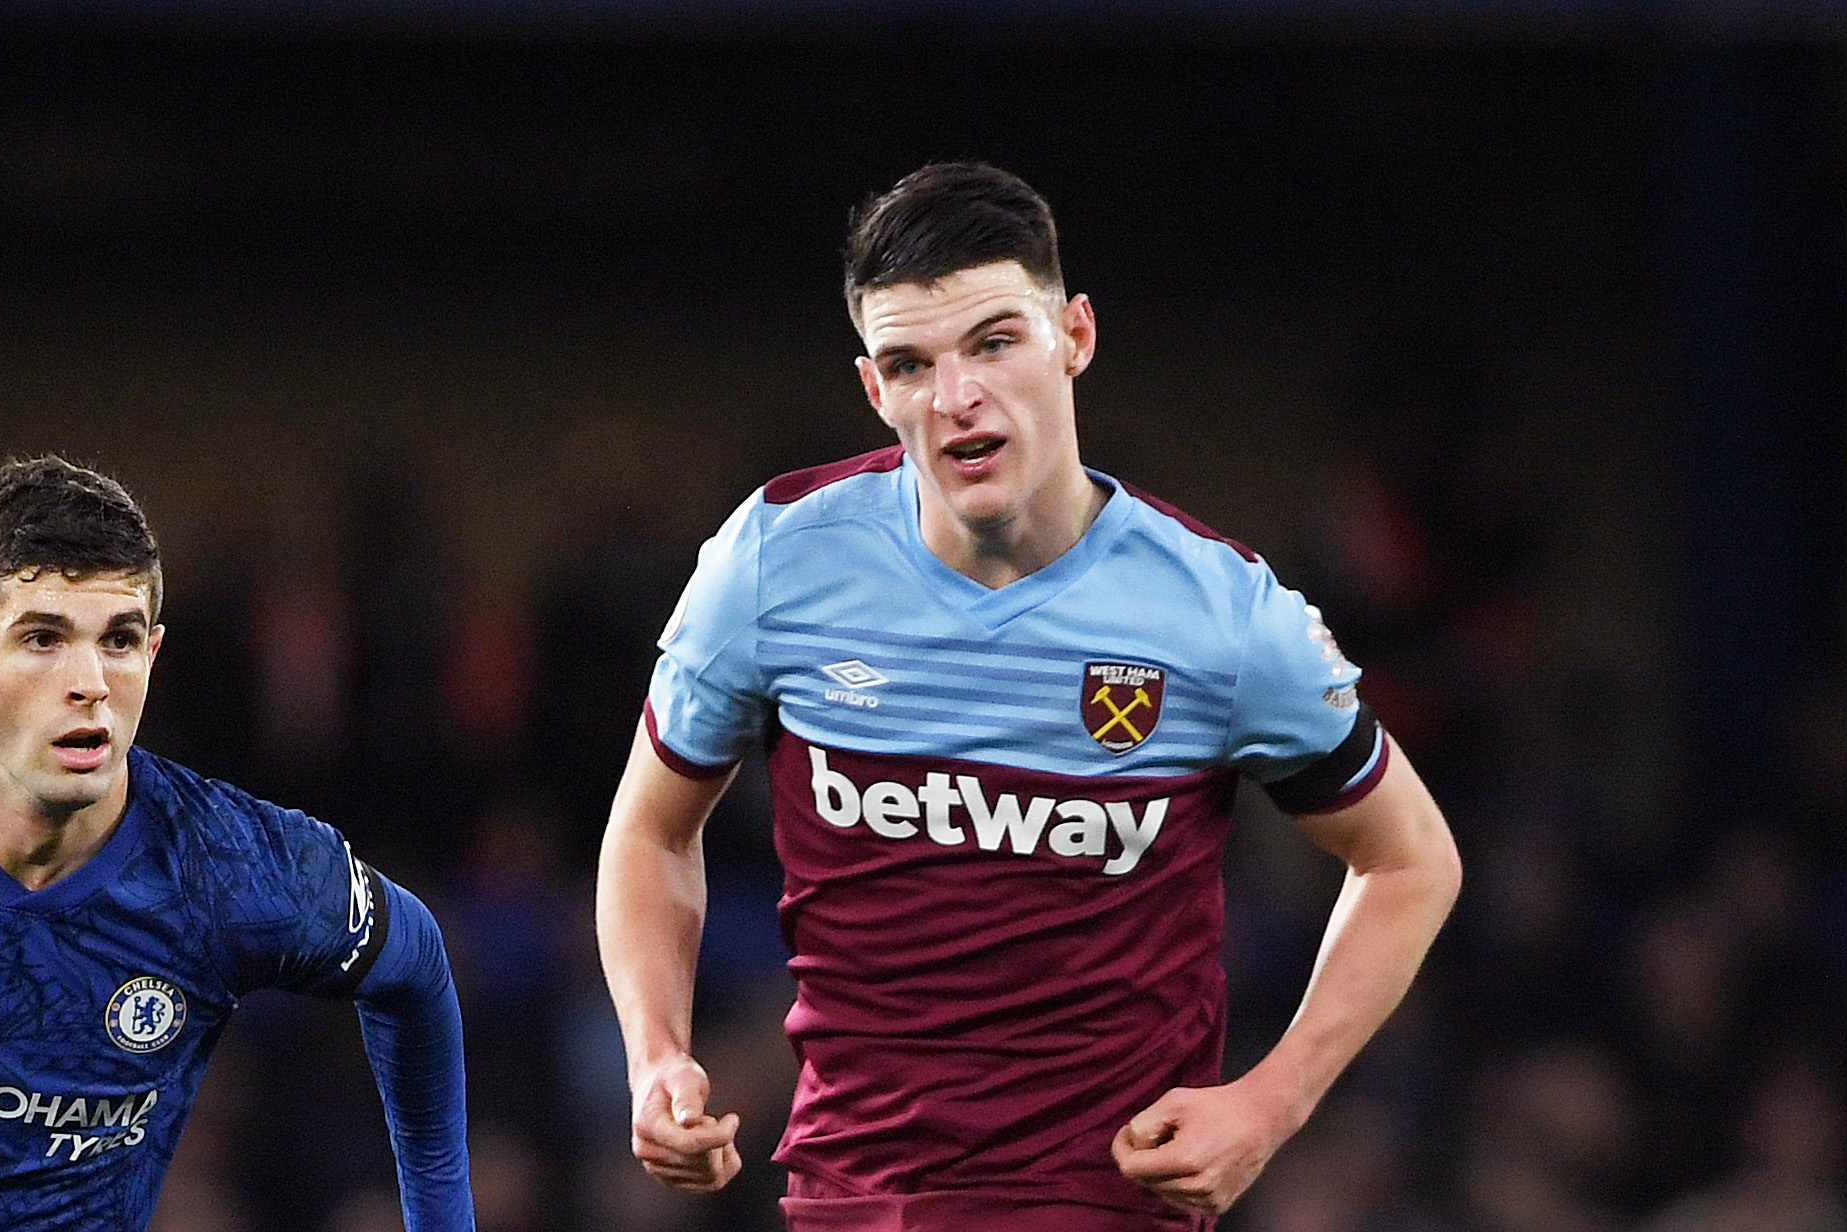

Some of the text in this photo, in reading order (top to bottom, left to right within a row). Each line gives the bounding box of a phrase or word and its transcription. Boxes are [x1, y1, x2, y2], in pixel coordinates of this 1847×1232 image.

[1090, 665, 1160, 680] WEST HAM
[824, 688, 879, 708] umbro
[809, 746, 1170, 875] betway
[123, 979, 175, 997] CHELSEA
